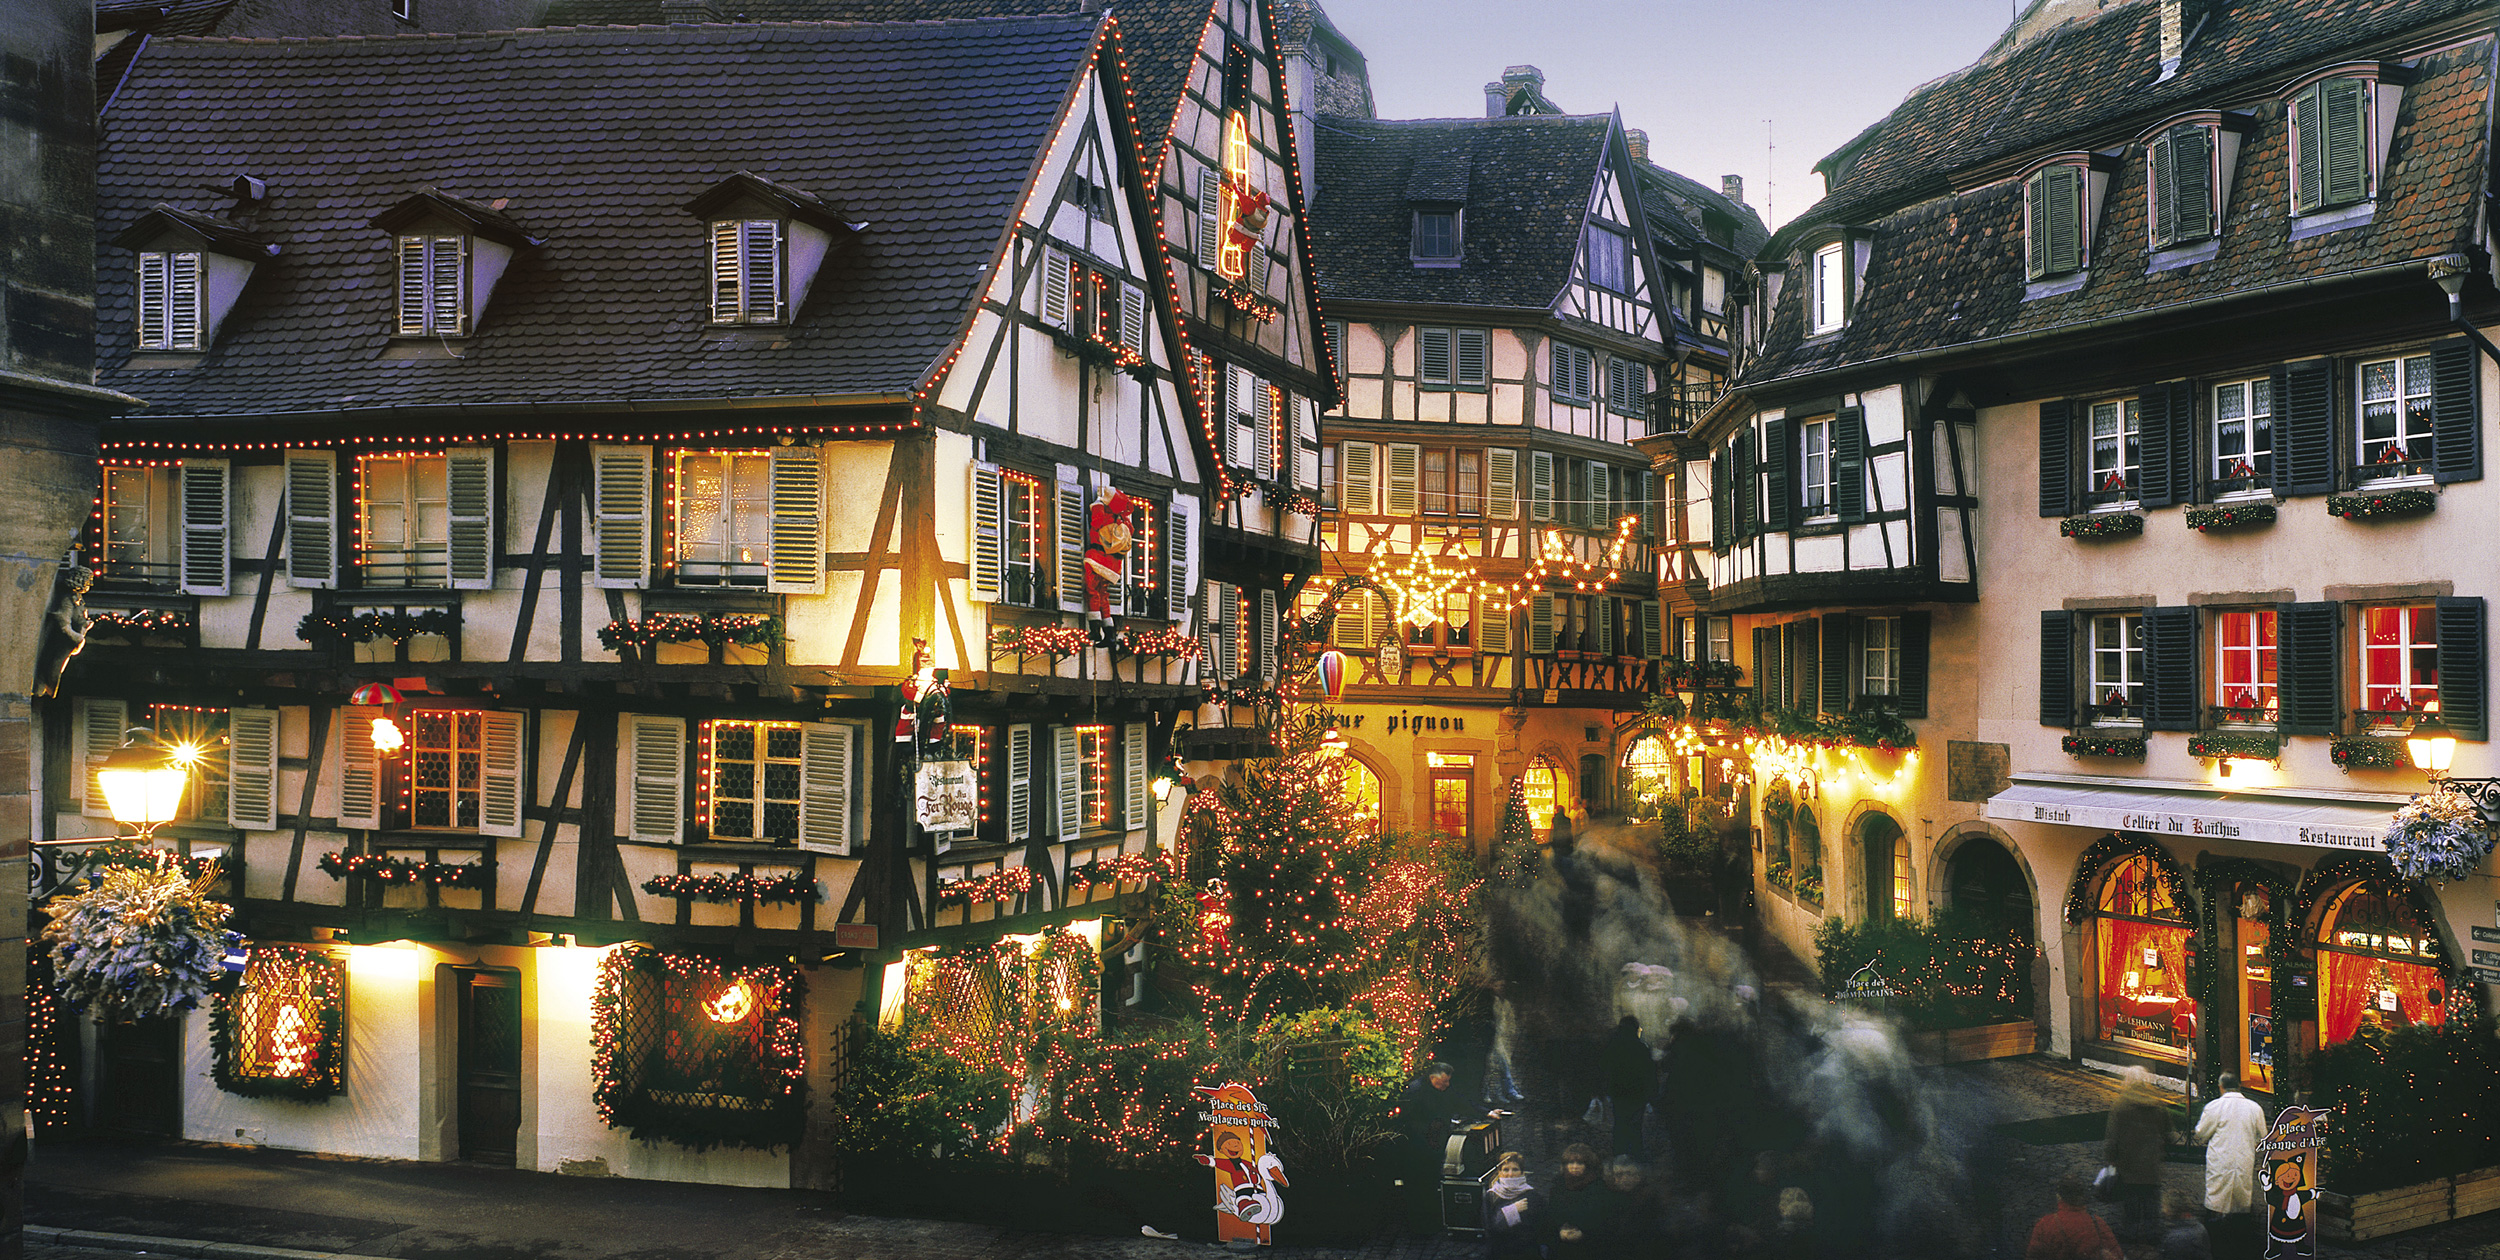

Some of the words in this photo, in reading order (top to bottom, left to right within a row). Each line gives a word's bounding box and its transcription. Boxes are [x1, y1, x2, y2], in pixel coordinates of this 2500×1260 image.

[1387, 709, 1464, 735] pignon
[929, 774, 964, 788] Restaurant
[917, 794, 940, 819] Fer
[939, 793, 973, 817] Rouge
[2034, 806, 2071, 822] Wistub
[2123, 814, 2160, 831] Cellier
[2167, 817, 2183, 833] du
[2299, 827, 2376, 848] Restaurant
[2284, 961, 2315, 969] ALSACE
[1844, 979, 1870, 988] Place
[1871, 978, 1886, 987] des
[1835, 988, 1895, 1000] DOMINICAINS
[2127, 1017, 2165, 1032] LEHMANN
[2131, 1029, 2167, 1044] Distillateur
[1210, 1098, 1234, 1110] Place
[1236, 1101, 1252, 1112] des
[1198, 1111, 1248, 1127] Montagnes
[2279, 1122, 2307, 1135] Place
[2261, 1140, 2297, 1151] Jeanne
[2299, 1137, 2327, 1148] d'Arc
